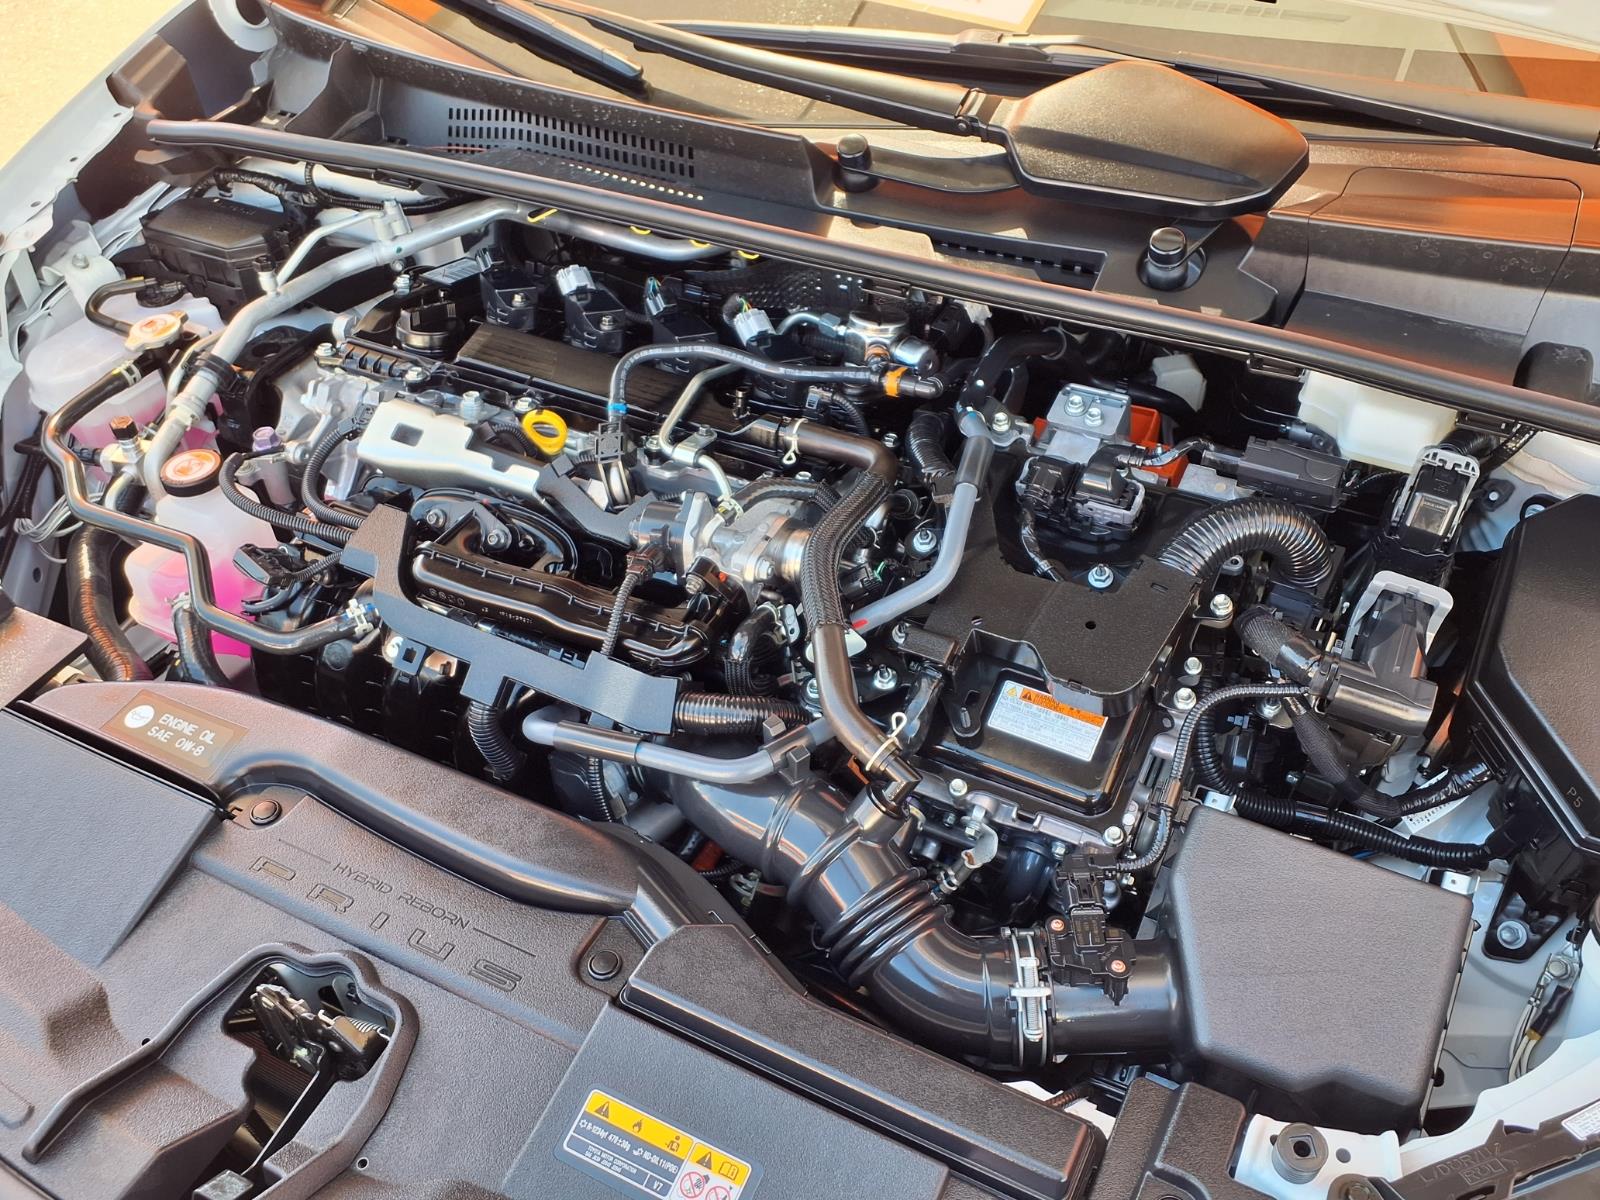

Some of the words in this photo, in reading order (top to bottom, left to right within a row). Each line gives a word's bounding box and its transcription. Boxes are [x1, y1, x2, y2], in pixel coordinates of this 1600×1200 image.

[147, 726, 174, 743] SAE
[159, 713, 199, 736] ENGINE
[199, 730, 216, 744] OIL
[333, 861, 394, 895] HYBRID
[397, 891, 471, 931] REBORN
